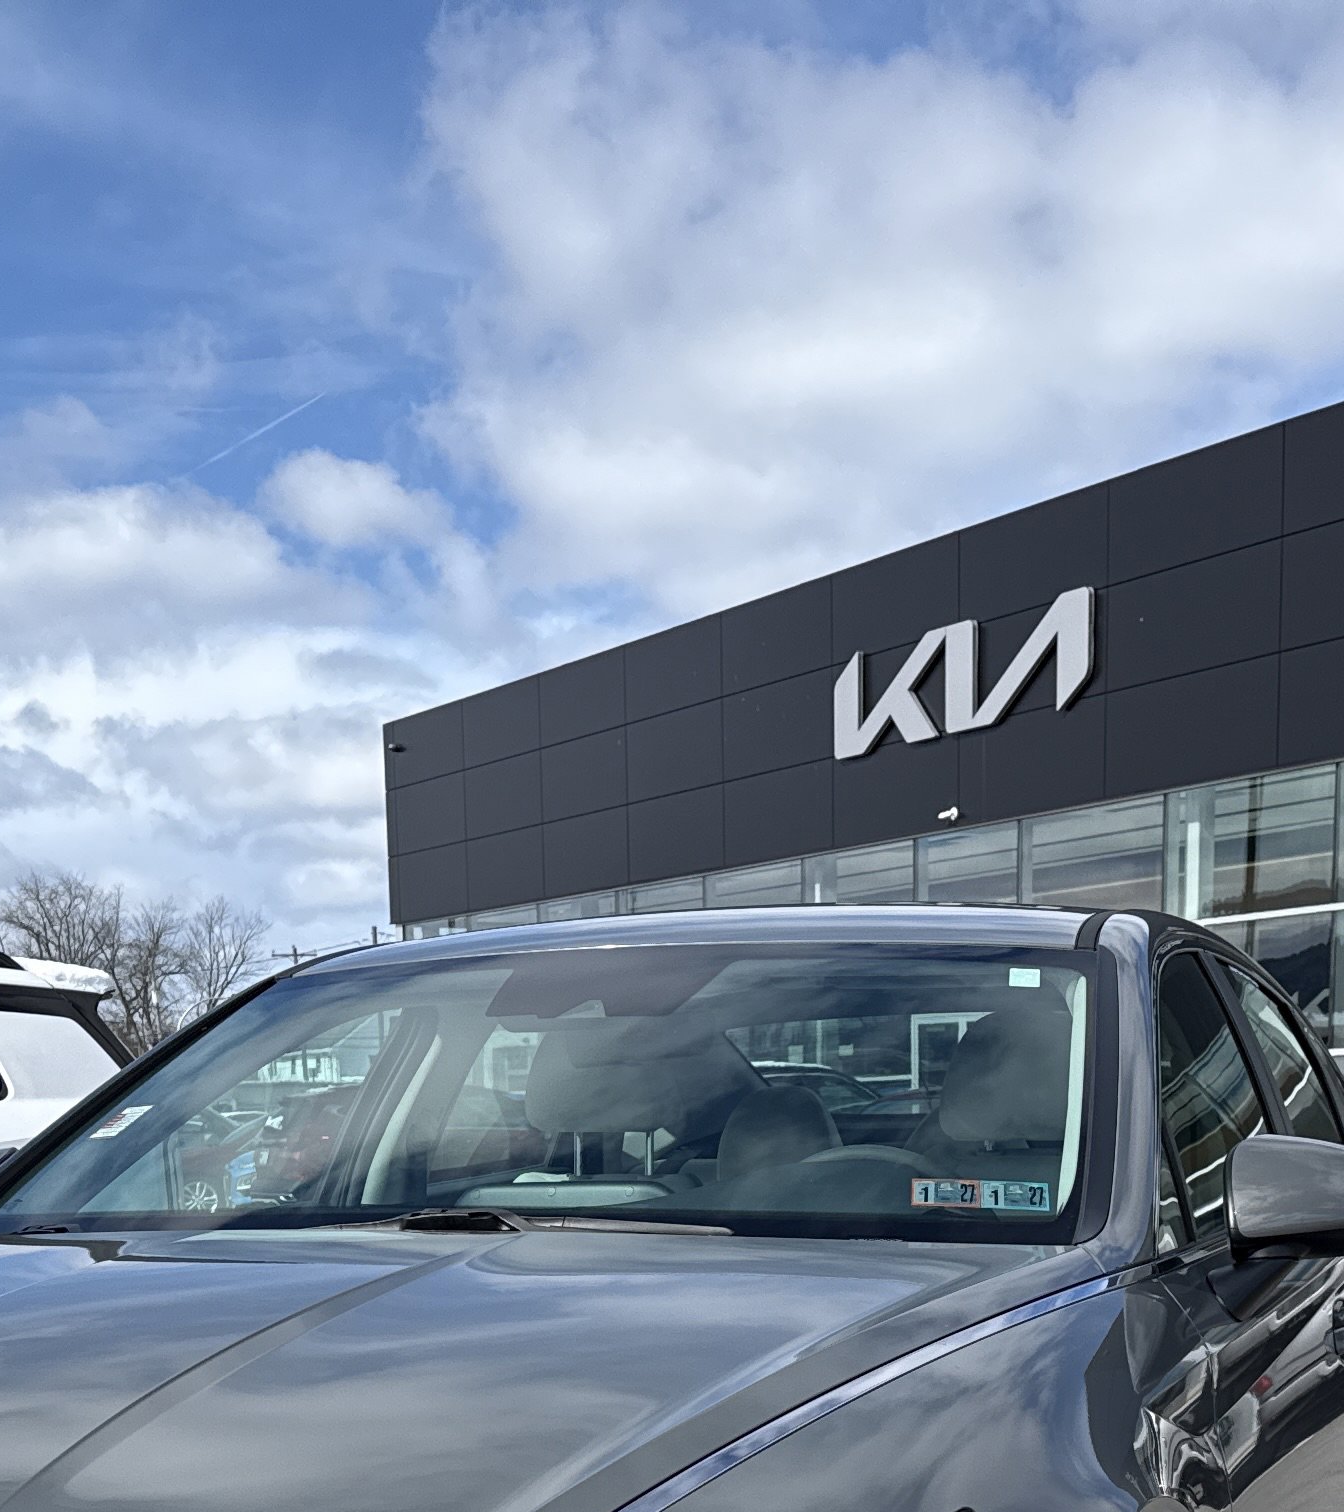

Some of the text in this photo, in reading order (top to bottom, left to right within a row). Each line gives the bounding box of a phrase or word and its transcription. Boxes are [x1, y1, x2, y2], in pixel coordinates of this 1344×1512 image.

[833, 586, 1095, 760] KIA
[920, 1183, 975, 1204] 1 27
[991, 1185, 1044, 1207] 1 27
